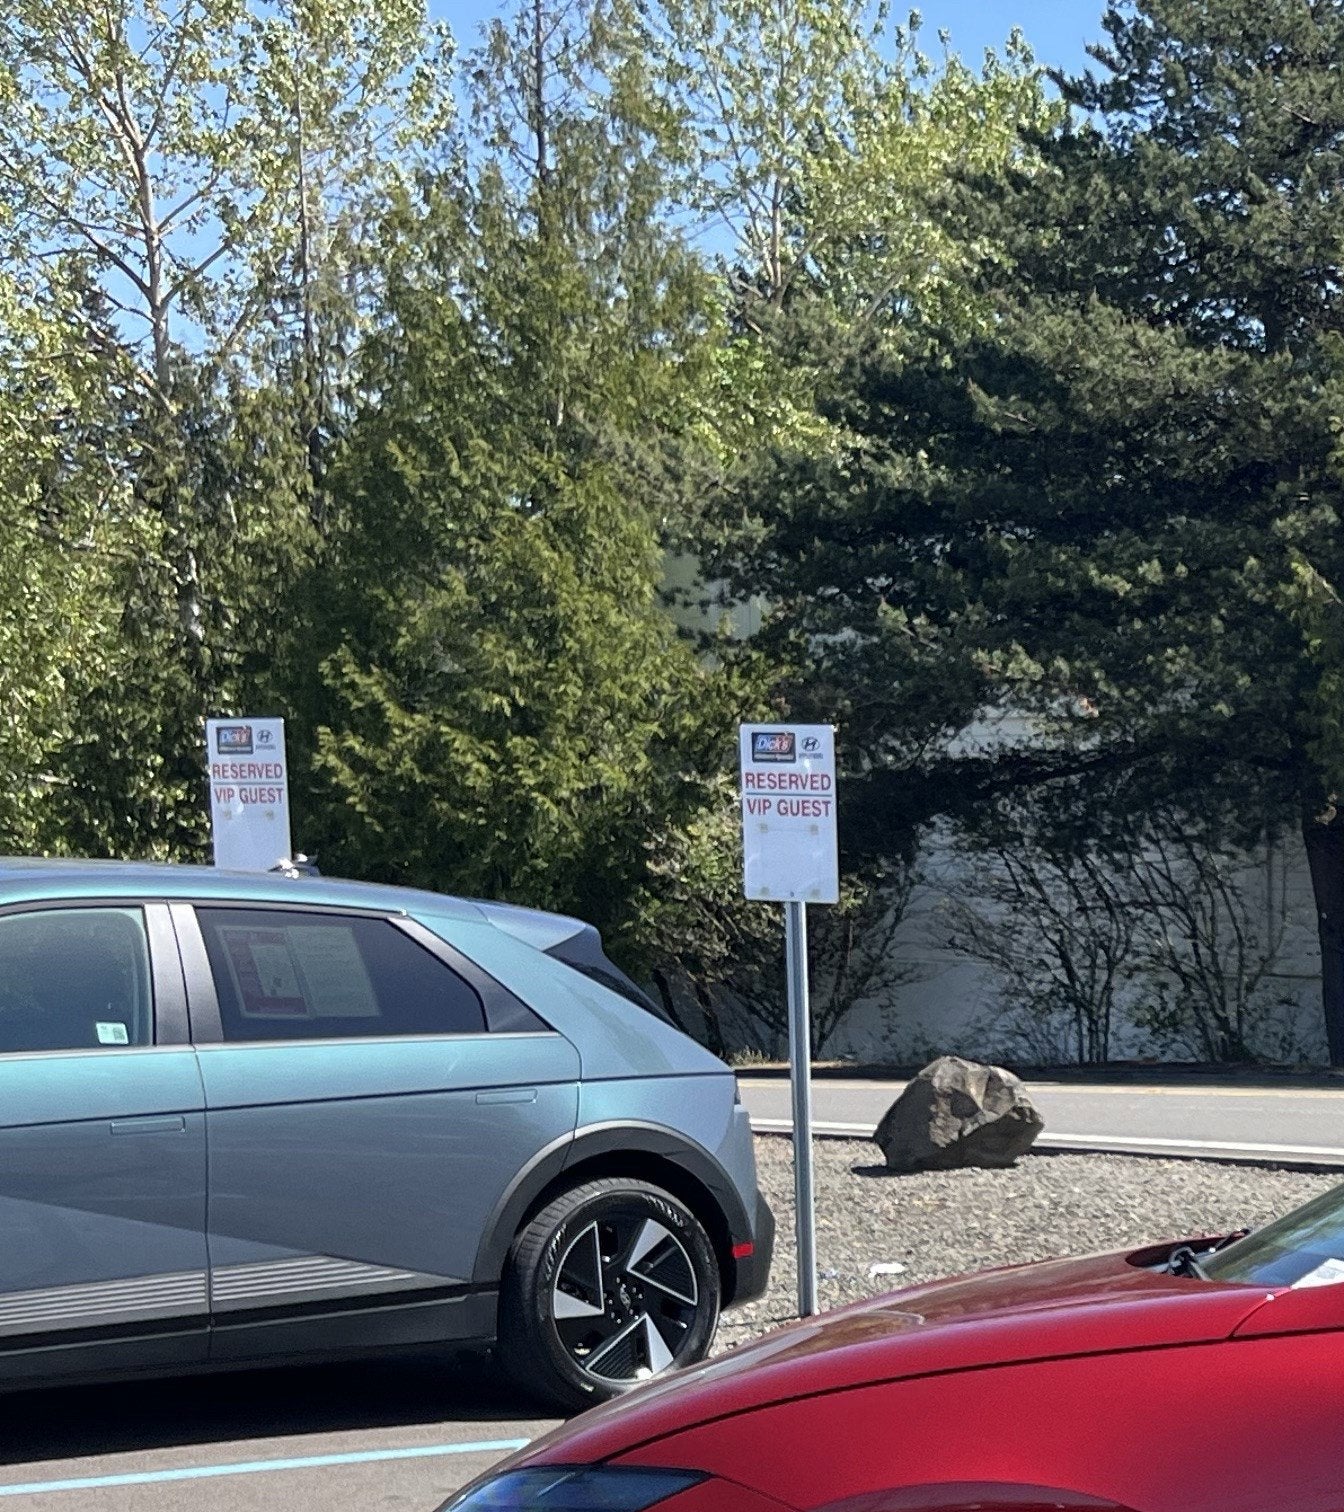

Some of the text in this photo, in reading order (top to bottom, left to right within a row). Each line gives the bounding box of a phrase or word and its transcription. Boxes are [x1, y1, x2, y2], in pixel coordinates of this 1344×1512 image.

[212, 763, 283, 780] RESERVED
[744, 772, 831, 791] RESERVED
[214, 787, 284, 805] VIP GUEST
[746, 799, 832, 817] VIP GUEST
